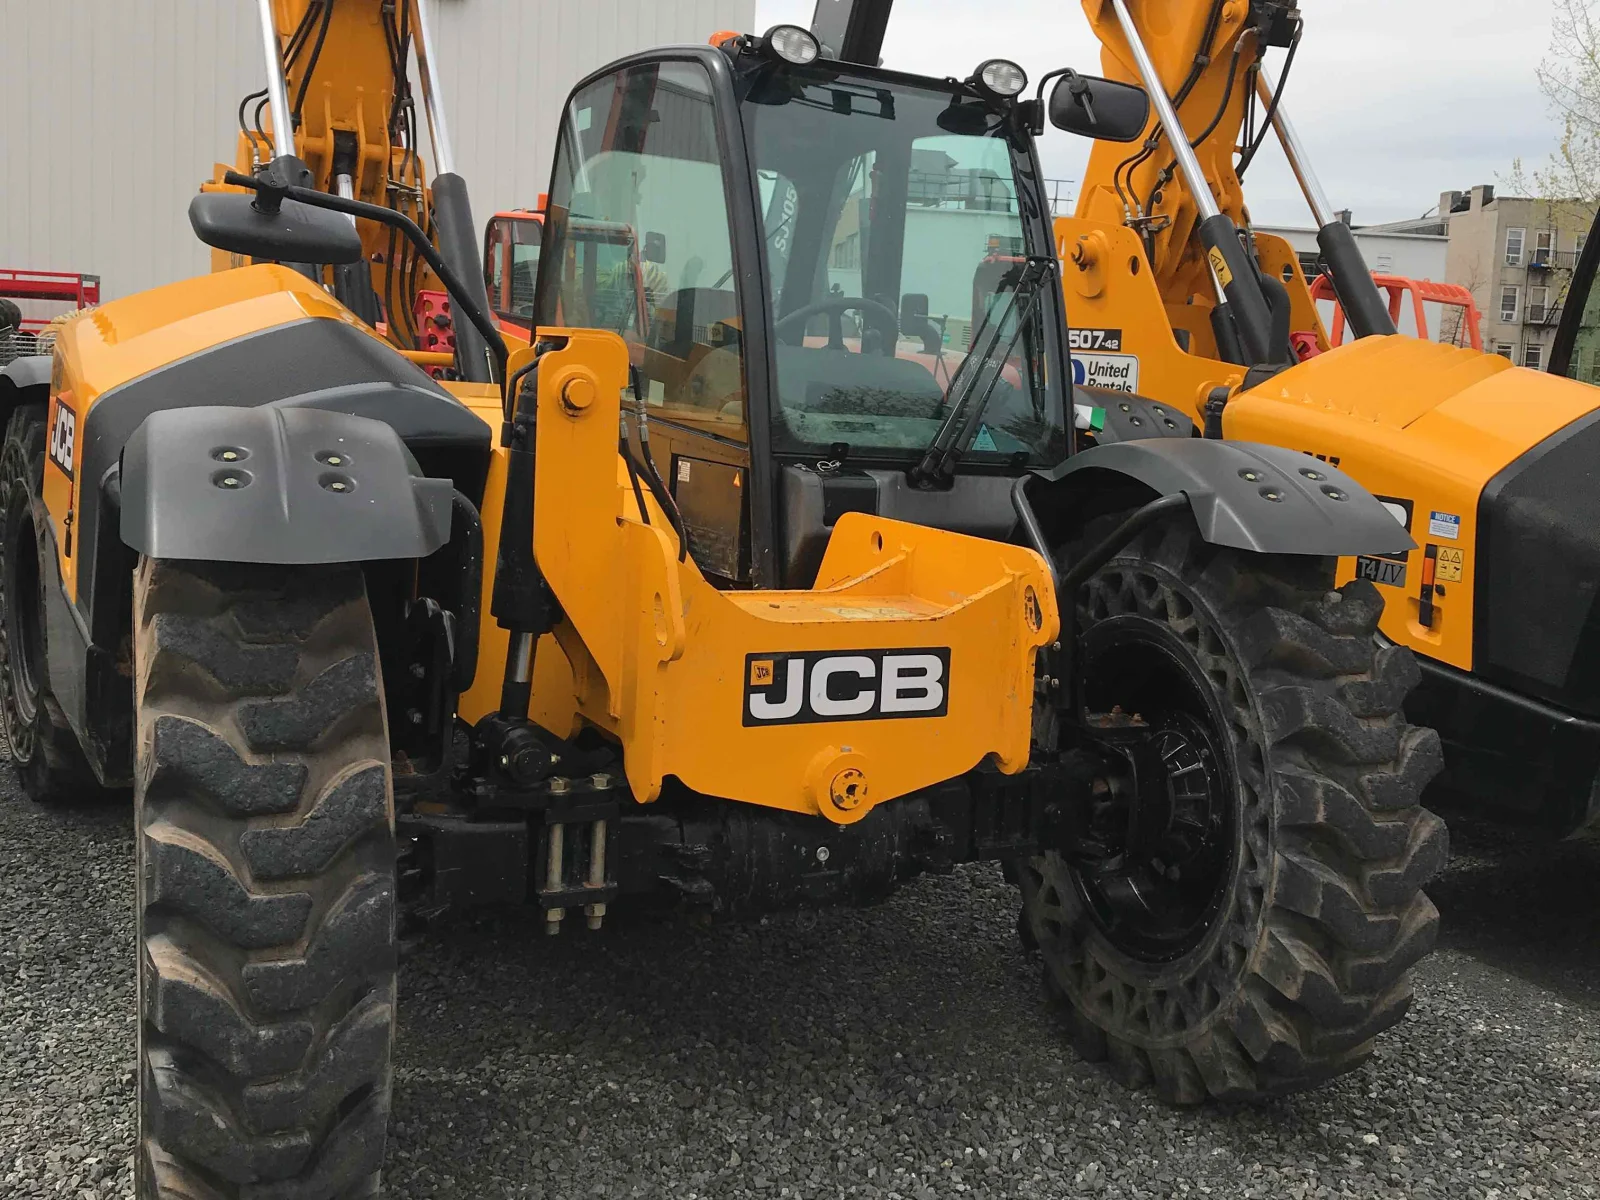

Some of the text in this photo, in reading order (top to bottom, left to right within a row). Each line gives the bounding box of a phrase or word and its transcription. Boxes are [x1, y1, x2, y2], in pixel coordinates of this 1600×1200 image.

[1088, 361, 1130, 378] United
[51, 404, 75, 472] JCB
[1434, 512, 1456, 524] NOTICE
[1359, 559, 1405, 583] T4 IV
[754, 665, 771, 680] JCB
[750, 654, 944, 719] JCB
